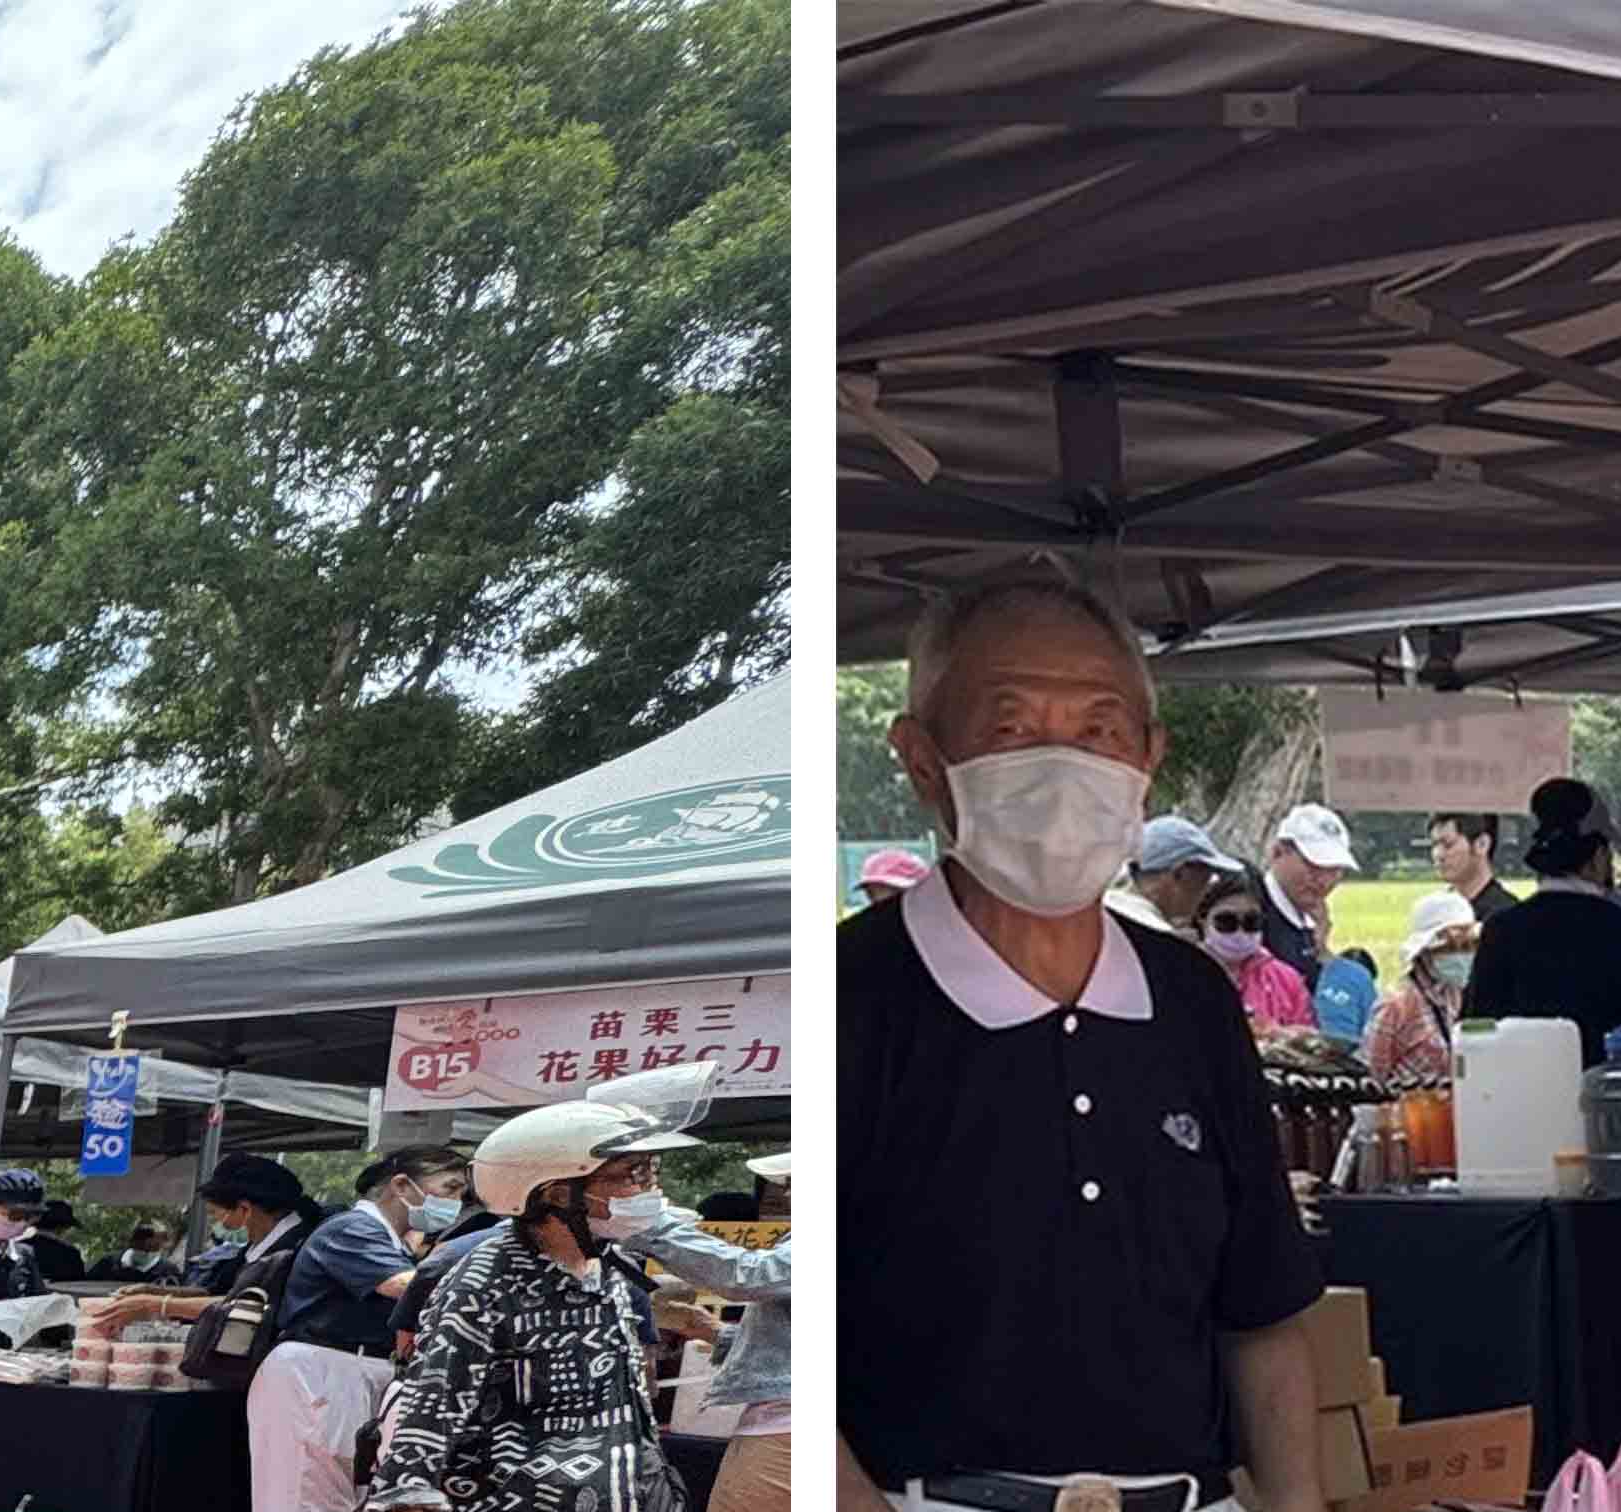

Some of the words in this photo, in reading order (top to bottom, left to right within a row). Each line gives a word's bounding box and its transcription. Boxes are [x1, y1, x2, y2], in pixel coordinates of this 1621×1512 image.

[589, 1003, 736, 1041] 苗栗三
[409, 1050, 472, 1081] B15
[84, 1133, 124, 1160] 50
